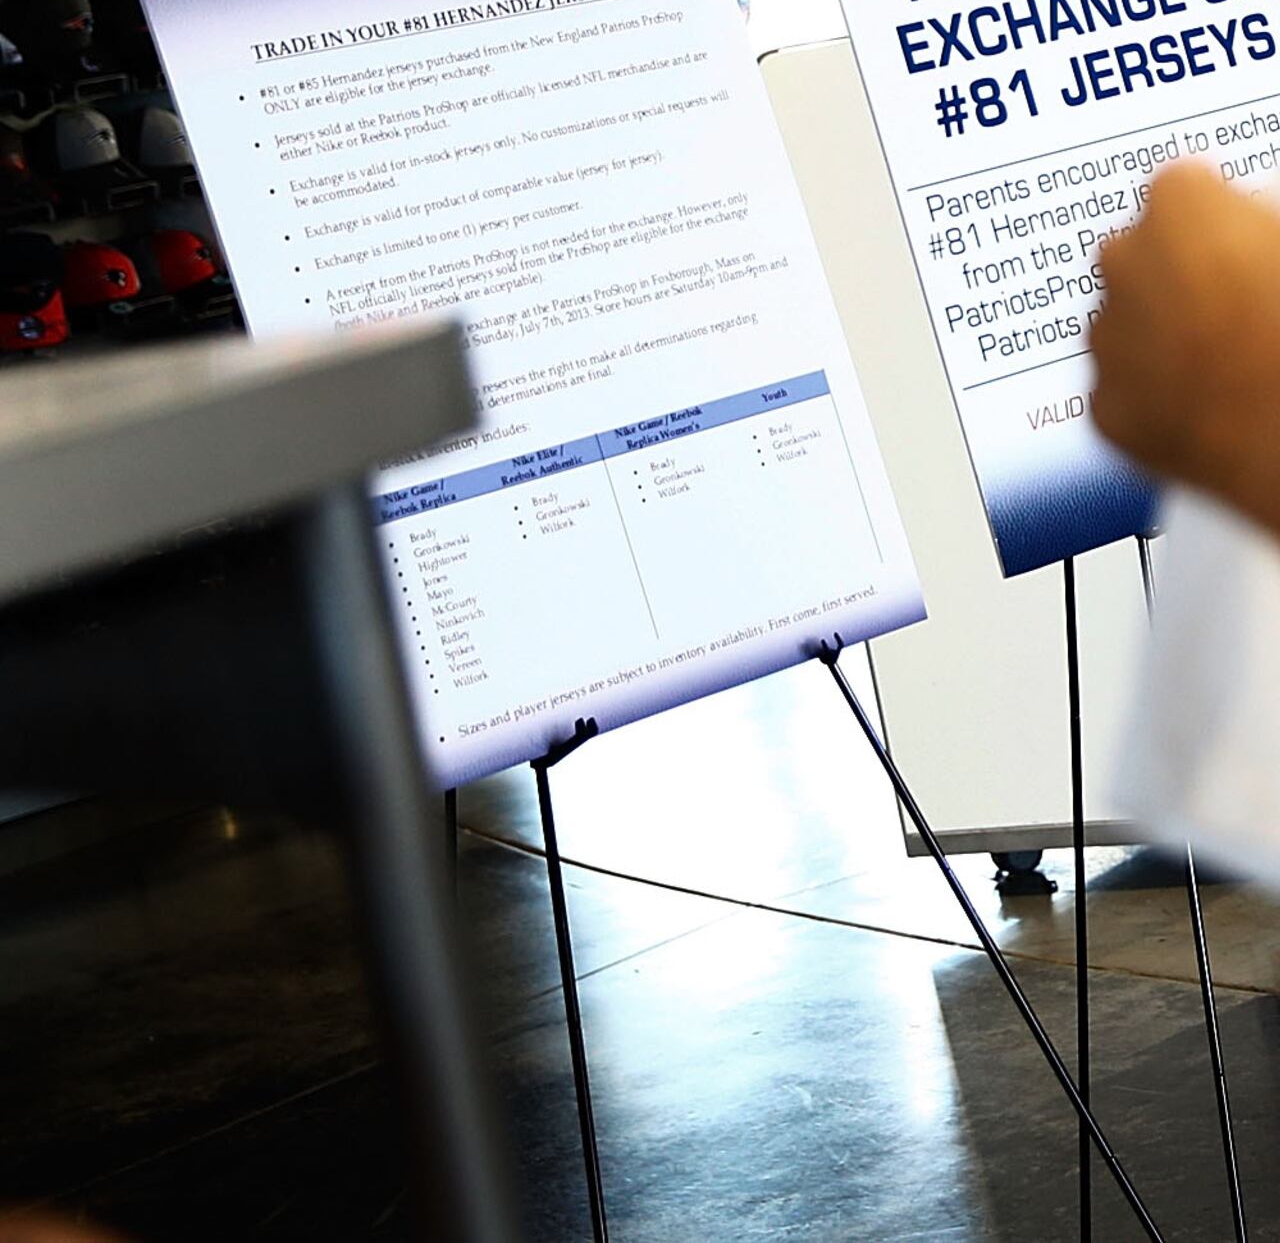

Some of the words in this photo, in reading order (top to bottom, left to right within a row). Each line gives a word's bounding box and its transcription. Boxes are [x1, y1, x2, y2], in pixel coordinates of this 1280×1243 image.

[248, 32, 321, 62] TRADE
[318, 28, 345, 50] IN
[343, 19, 402, 45] YOUR
[401, 13, 432, 34] #81
[258, 83, 283, 100] #81
[281, 83, 297, 97] or
[296, 76, 321, 94] #85
[319, 66, 387, 89] Hernandez
[384, 59, 426, 80] jerseys
[424, 45, 483, 72] purchased
[481, 43, 512, 59] from
[509, 38, 530, 53] the
[527, 33, 555, 49] New
[555, 23, 601, 45] England
[598, 18, 642, 36] Patriots
[639, 10, 685, 28] ProShop
[262, 95, 301, 117] ONLY
[303, 94, 324, 110] are
[323, 84, 368, 105] eligible
[366, 81, 386, 97] for
[385, 78, 407, 93] the
[405, 72, 440, 92] jersey
[272, 129, 317, 151] Jerseys
[315, 120, 344, 140] sold
[343, 119, 357, 134] at
[356, 116, 378, 131] the
[376, 108, 423, 127] Patriots
[421, 98, 471, 118] ProShop
[470, 94, 490, 109] are
[489, 83, 537, 105] officially
[536, 73, 583, 95] licensed
[580, 68, 608, 86] NFL
[606, 58, 671, 81] merchandise
[670, 51, 693, 68] and
[692, 51, 709, 63] are
[934, 68, 1039, 139] #81
[1060, 12, 1277, 108] JERSEYS
[278, 145, 314, 163] either
[313, 138, 345, 156] Nike
[344, 136, 360, 149] or
[358, 125, 404, 146] Reebok
[287, 172, 346, 194] Exchange
[345, 168, 359, 182] is
[358, 160, 390, 179] valid
[388, 158, 408, 173] for
[407, 147, 454, 169] in-stock
[452, 141, 493, 162] jerseys
[519, 129, 540, 145] No
[538, 115, 619, 141] customizations
[617, 112, 631, 124] or
[630, 101, 667, 124] special
[666, 95, 710, 115] requests
[709, 88, 731, 103] will
[926, 178, 1031, 223] Parents
[1037, 132, 1181, 194] encouraged
[1184, 130, 1210, 155] to
[292, 195, 310, 210] be
[302, 217, 361, 240] Exchange
[359, 214, 373, 228] is
[372, 205, 404, 224] valid
[403, 203, 423, 218] for
[422, 192, 469, 218] product
[467, 187, 481, 204] of
[480, 175, 545, 201] comparable
[543, 169, 576, 186] value
[574, 163, 610, 182] (jersey
[610, 157, 628, 172] for
[928, 222, 982, 261] #81
[990, 190, 1129, 244] Hernandez
[312, 248, 371, 271] Exchange
[369, 244, 384, 259] is
[381, 233, 426, 256] limited
[423, 233, 439, 246] to
[438, 228, 462, 243] one
[477, 216, 511, 236] jersey
[510, 211, 532, 229] per
[962, 256, 1026, 290] from
[1030, 241, 1074, 271] the
[465, 311, 519, 335] exchange
[519, 306, 533, 321] at
[531, 302, 551, 317] the
[549, 292, 594, 313] Patriots
[592, 281, 639, 302] ProShop
[638, 278, 651, 291] in
[713, 255, 742, 271] Mass
[741, 251, 757, 264] on
[517, 319, 542, 339] July
[592, 300, 623, 317] Store
[620, 292, 654, 310] hours
[653, 287, 672, 302] are
[669, 275, 717, 297] Saturday
[716, 263, 770, 285] 10am-9pm
[769, 254, 790, 272] and
[945, 262, 1107, 334] PatriotsProS
[977, 313, 1082, 362] Patriots
[1026, 394, 1085, 431] VALID
[456, 719, 489, 740] Sizes
[488, 708, 513, 729] and
[512, 698, 549, 724] player
[548, 685, 589, 711] jerseys
[587, 679, 607, 695] are
[605, 664, 645, 689] subject
[644, 661, 658, 675] to
[657, 643, 707, 671] inventory
[766, 614, 792, 632] First
[820, 596, 844, 614] first
